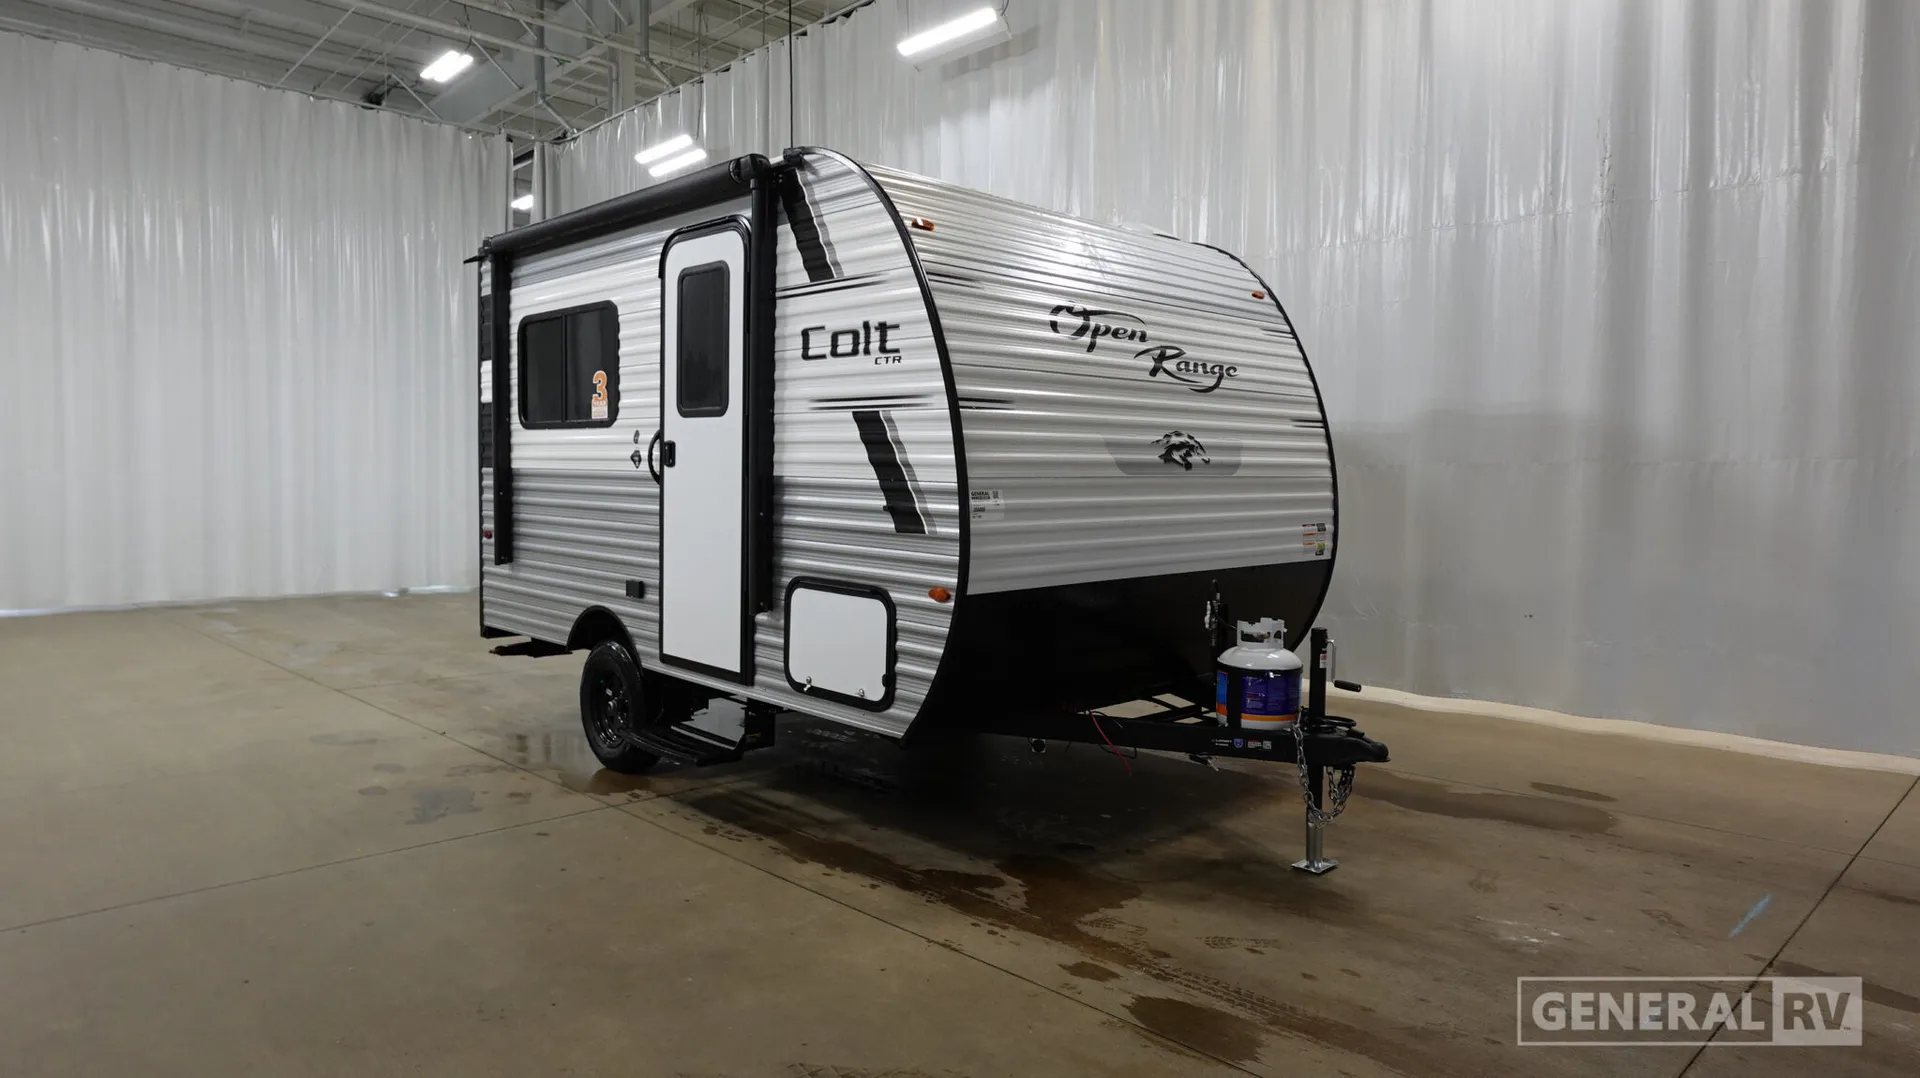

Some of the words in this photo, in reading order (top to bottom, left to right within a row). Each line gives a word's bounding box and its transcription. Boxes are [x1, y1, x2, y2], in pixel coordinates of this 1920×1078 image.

[801, 320, 900, 361] Colt
[1049, 301, 1148, 352] Open
[874, 356, 902, 365] CTR
[1134, 345, 1239, 393] Range
[592, 370, 608, 401] 3
